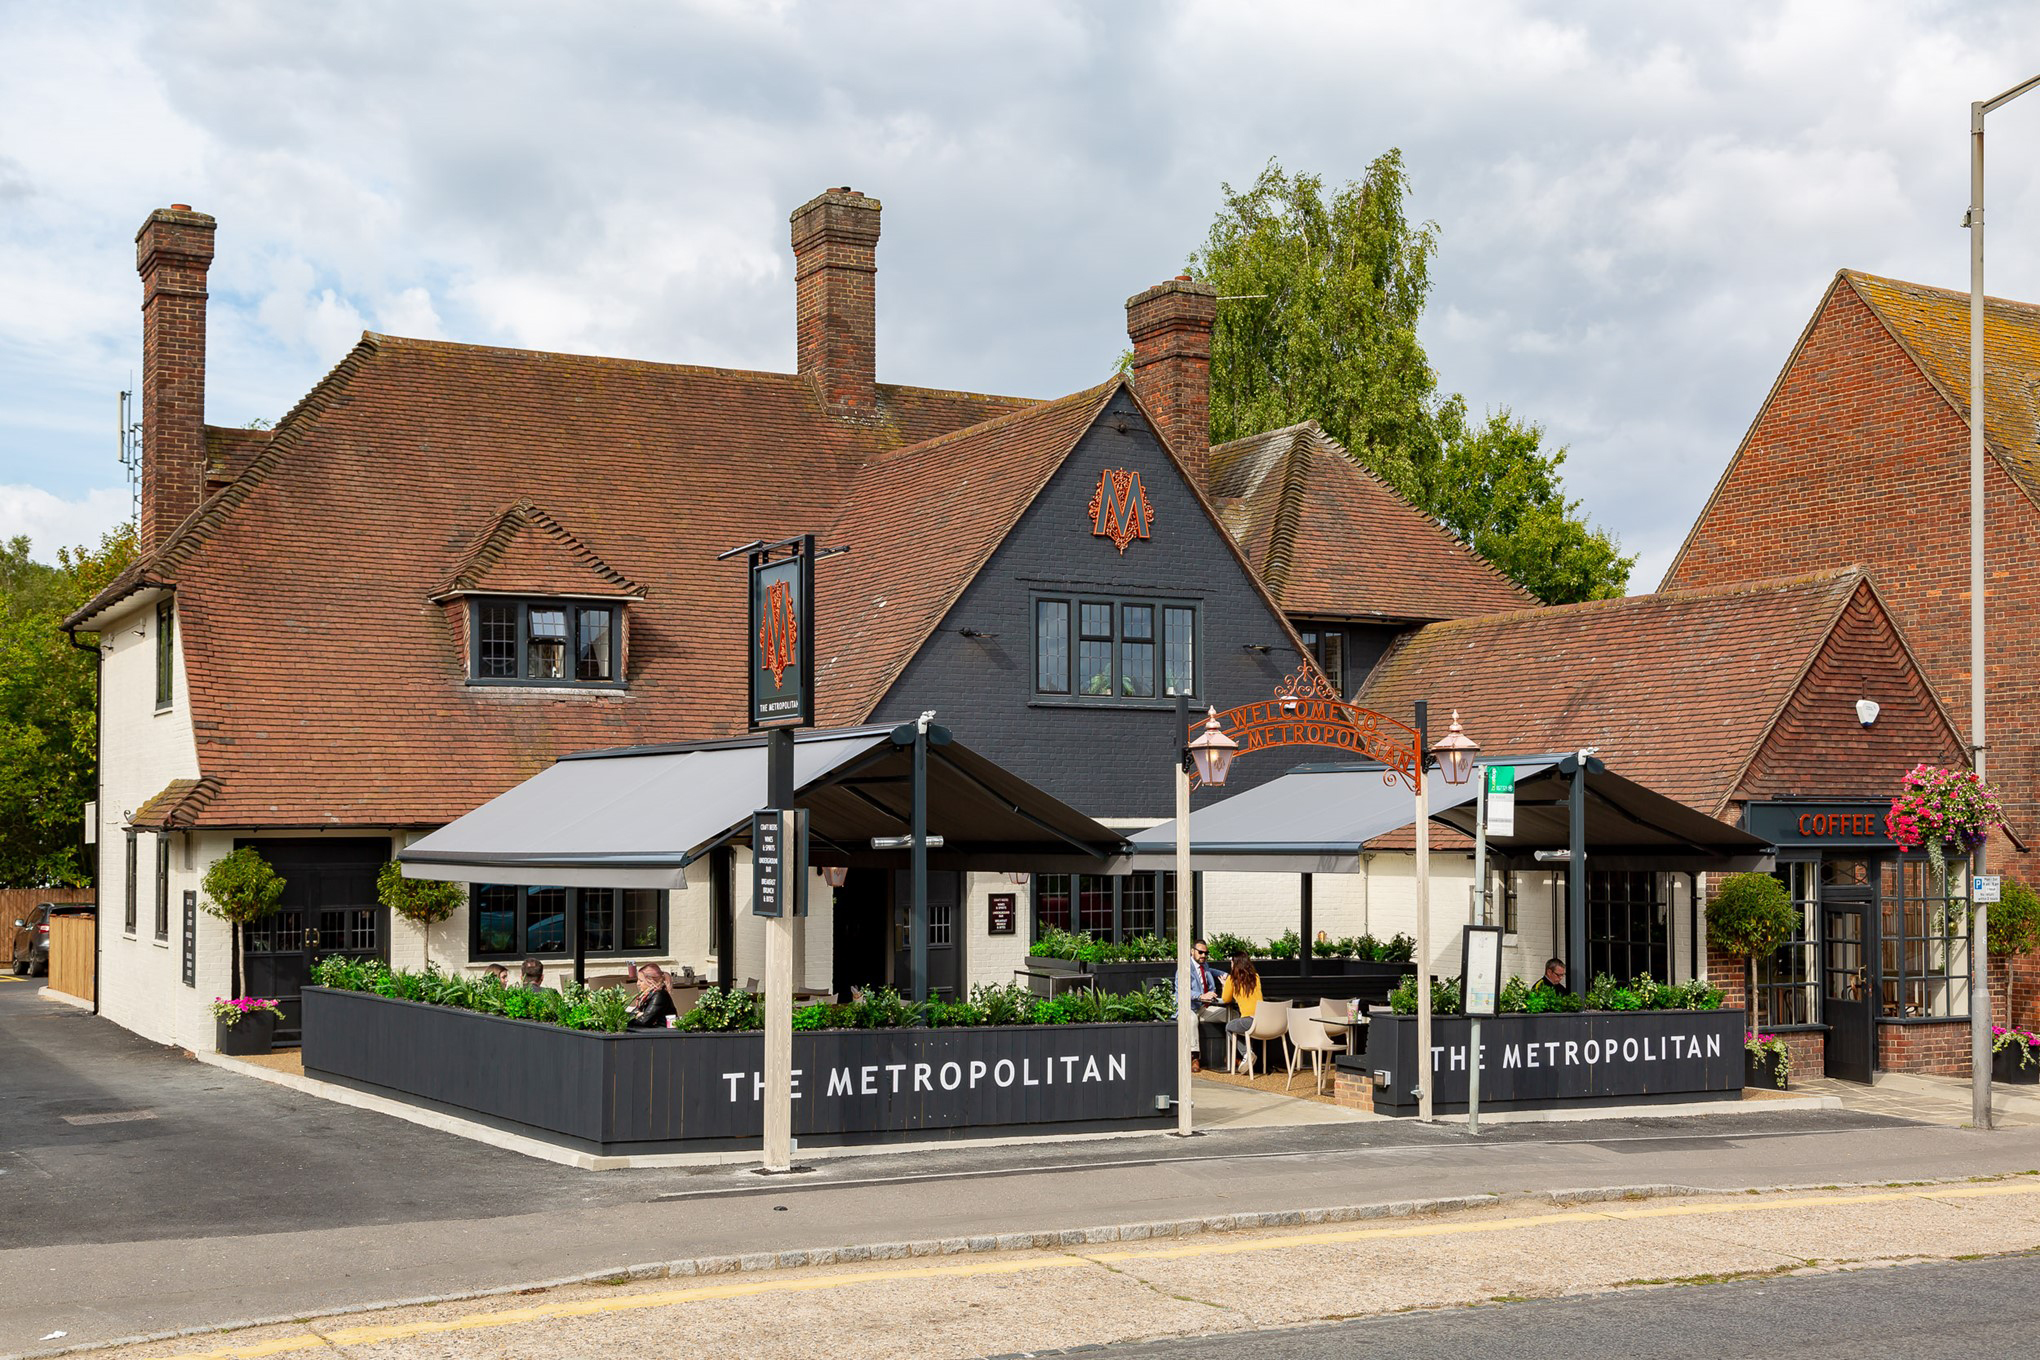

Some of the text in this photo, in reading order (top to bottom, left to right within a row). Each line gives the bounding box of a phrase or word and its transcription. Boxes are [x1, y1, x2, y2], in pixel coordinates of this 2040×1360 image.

[759, 703, 768, 712] THE
[1229, 702, 1377, 731] WELCOME TO
[1248, 724, 1411, 772] METROPOLITAN
[1799, 813, 1876, 836] COFFEE
[1502, 1033, 1721, 1069] METROPOLITAN
[826, 1053, 1127, 1097] METROPOLITAN
